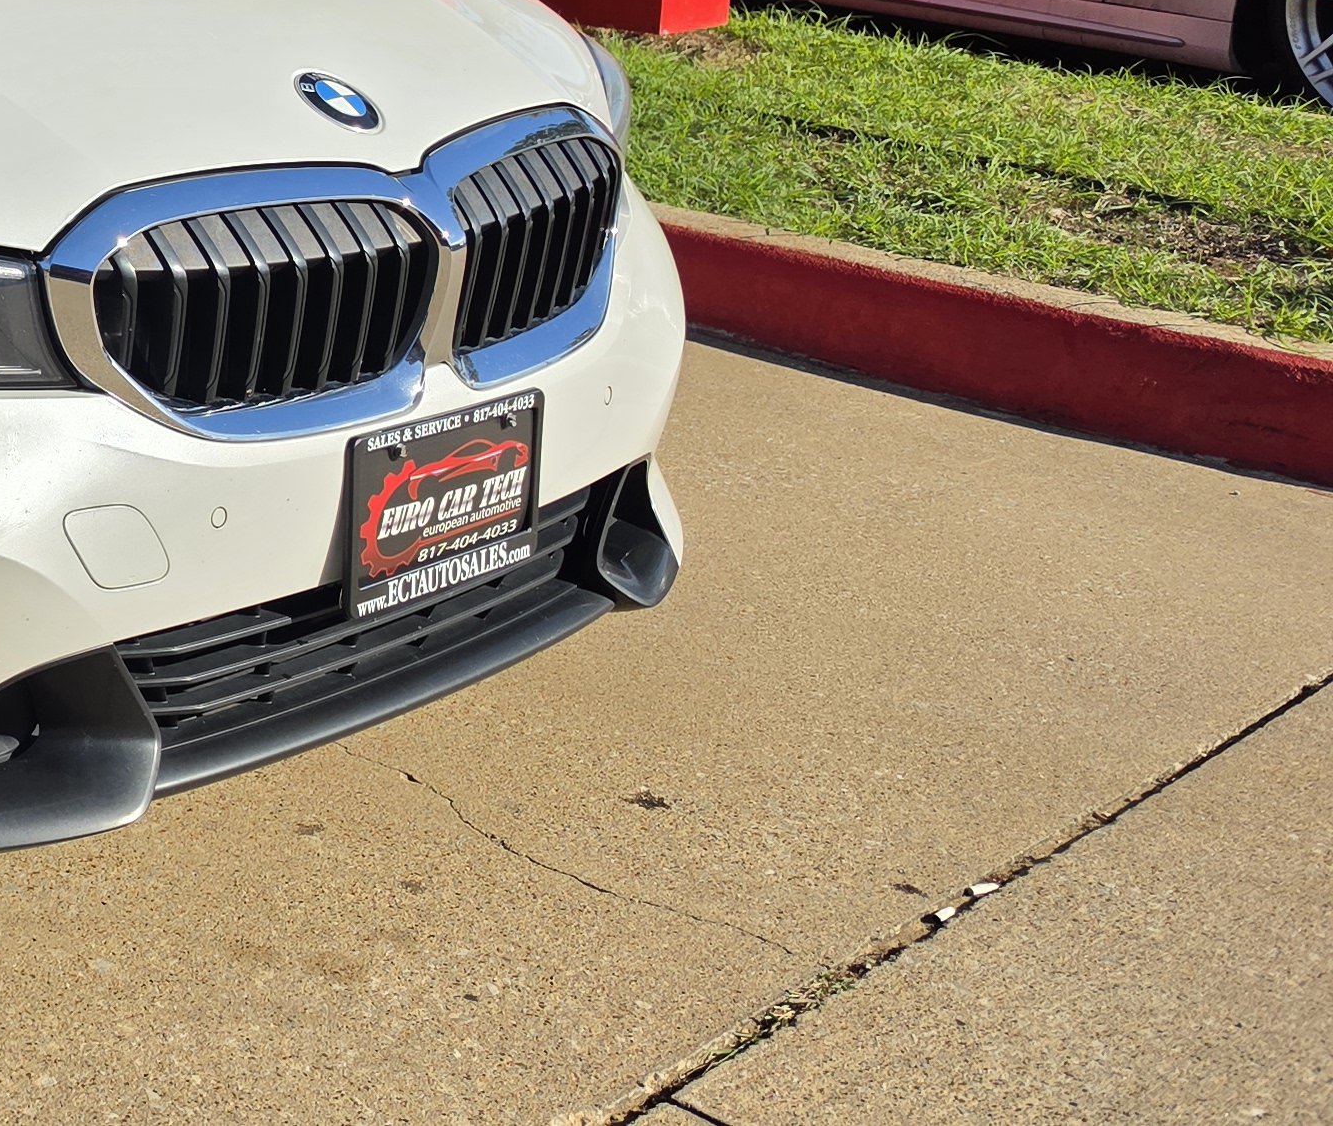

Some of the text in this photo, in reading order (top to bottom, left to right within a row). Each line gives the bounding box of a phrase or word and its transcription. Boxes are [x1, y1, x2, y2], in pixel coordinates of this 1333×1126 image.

[367, 394, 535, 452] SALES & SERVICE 817-404-4033
[377, 466, 528, 540] EURO CAR TECH
[422, 496, 523, 538] european automotive
[417, 518, 518, 563] 817-404-4033
[356, 541, 531, 618] www.ECTAUTOSALES.com
